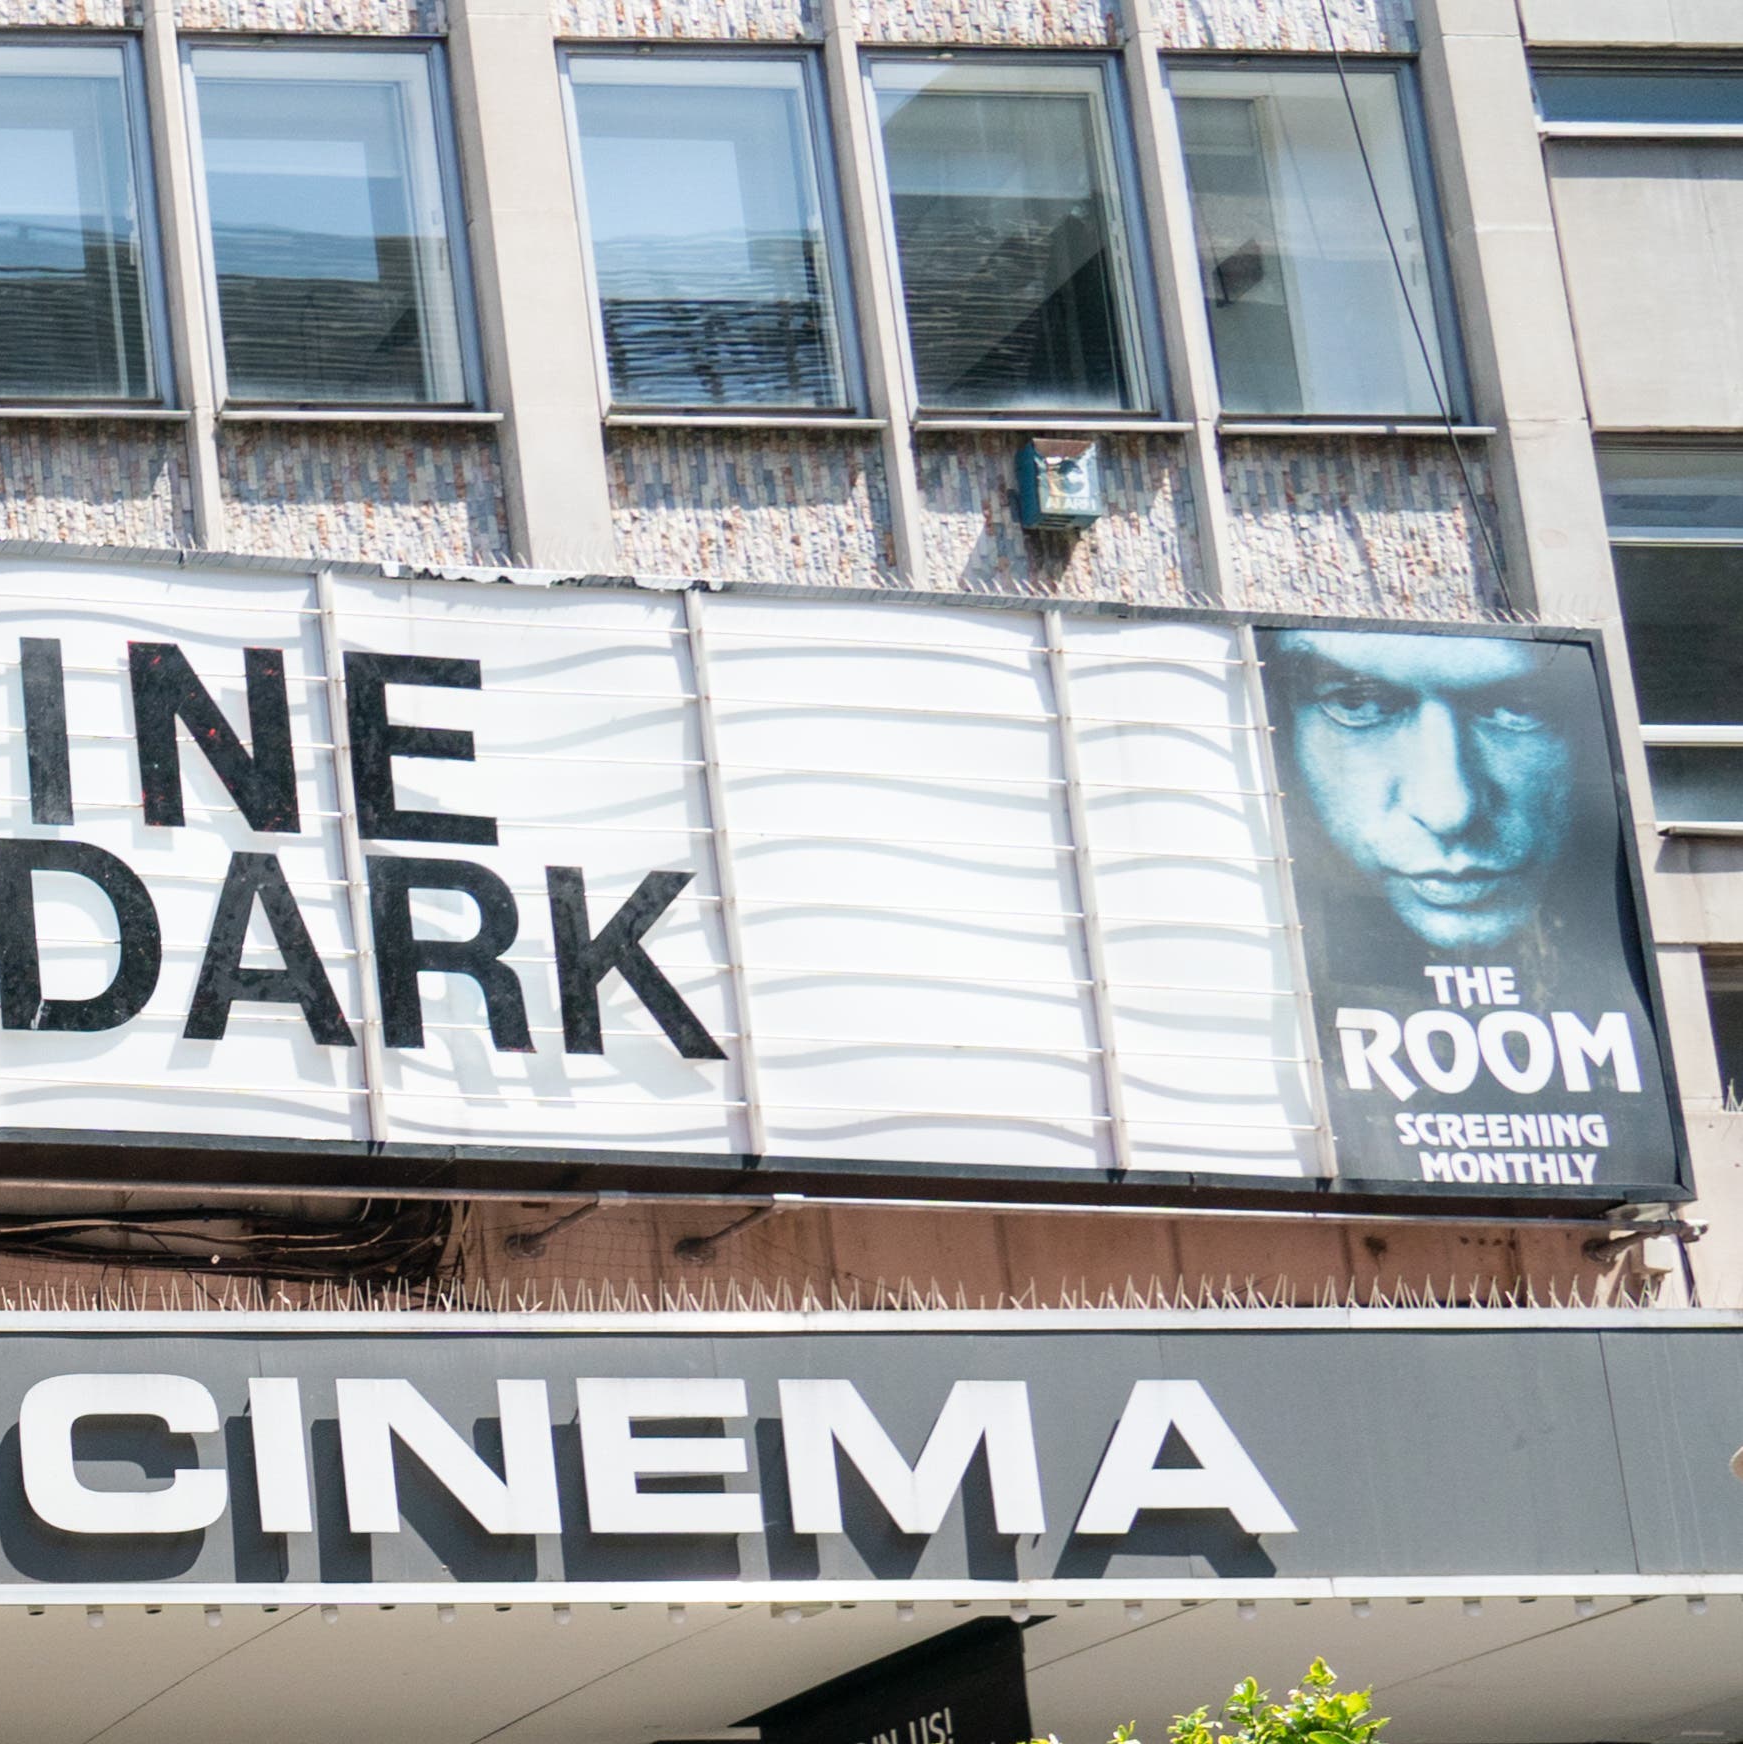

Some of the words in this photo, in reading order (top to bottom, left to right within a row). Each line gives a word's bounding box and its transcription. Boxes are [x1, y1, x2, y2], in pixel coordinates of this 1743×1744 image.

[1424, 965, 1521, 1009] THE
[1335, 1007, 1643, 1101] ROOM
[1394, 1112, 1609, 1149] SCREENING
[1419, 1152, 1598, 1186] MONTHLY
[19, 1372, 1302, 1536] CINEMA
